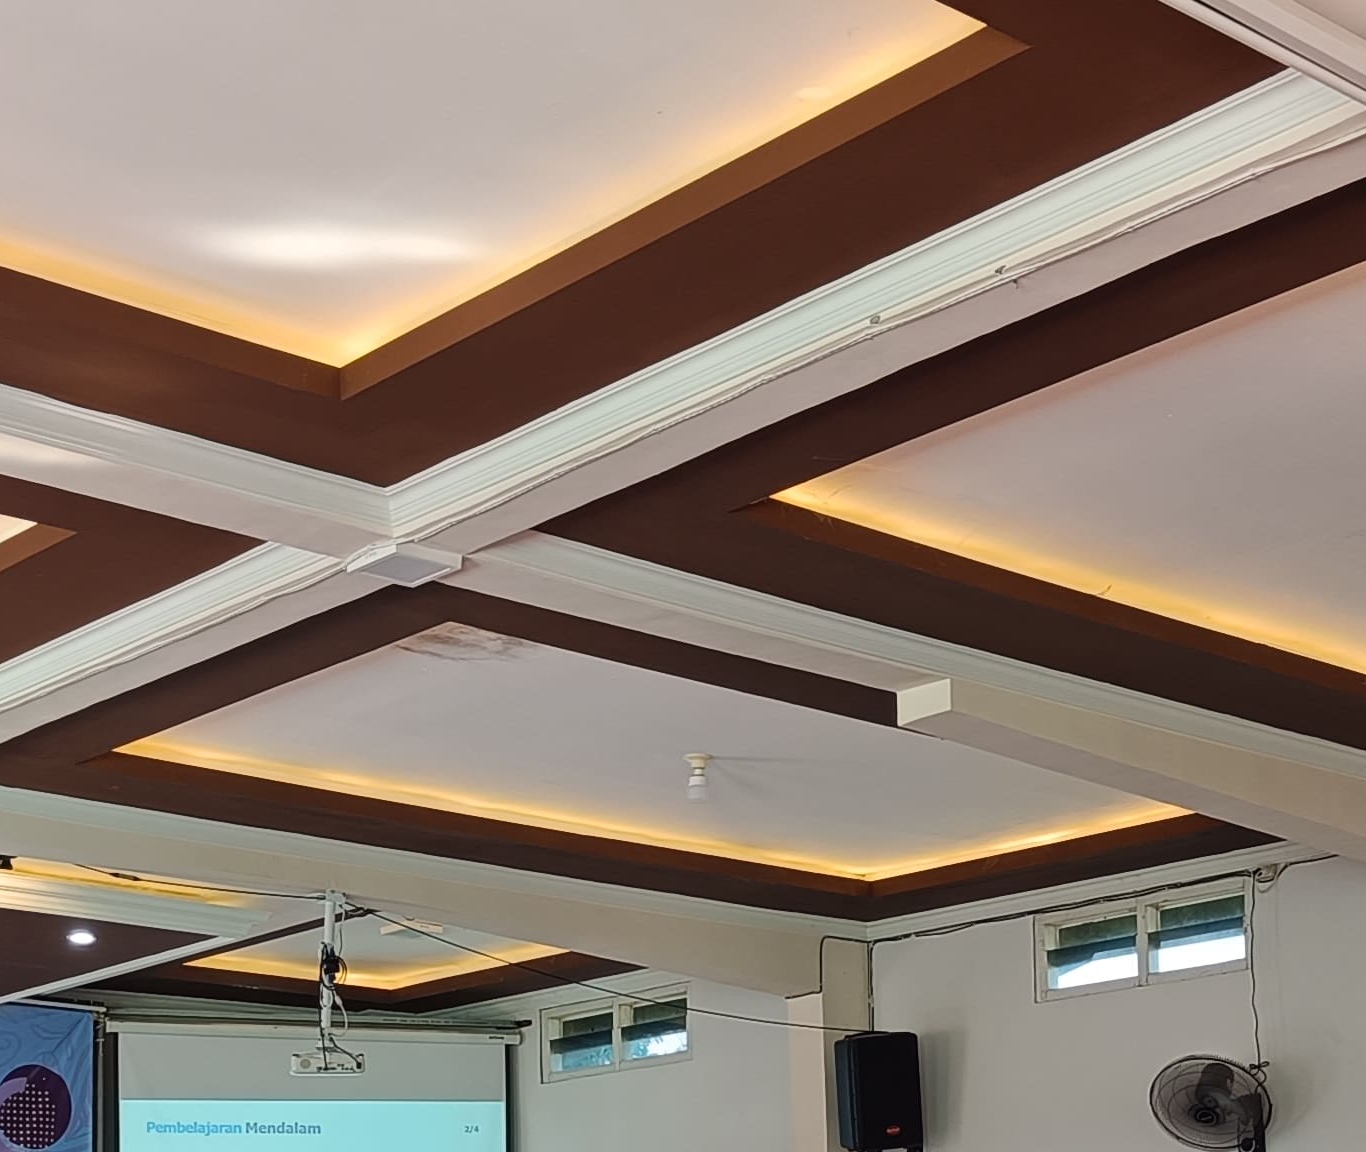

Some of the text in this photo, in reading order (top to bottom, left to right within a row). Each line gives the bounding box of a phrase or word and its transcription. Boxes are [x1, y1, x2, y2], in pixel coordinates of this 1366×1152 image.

[147, 1121, 480, 1136] Pembelajaran Mendalam 2/4
